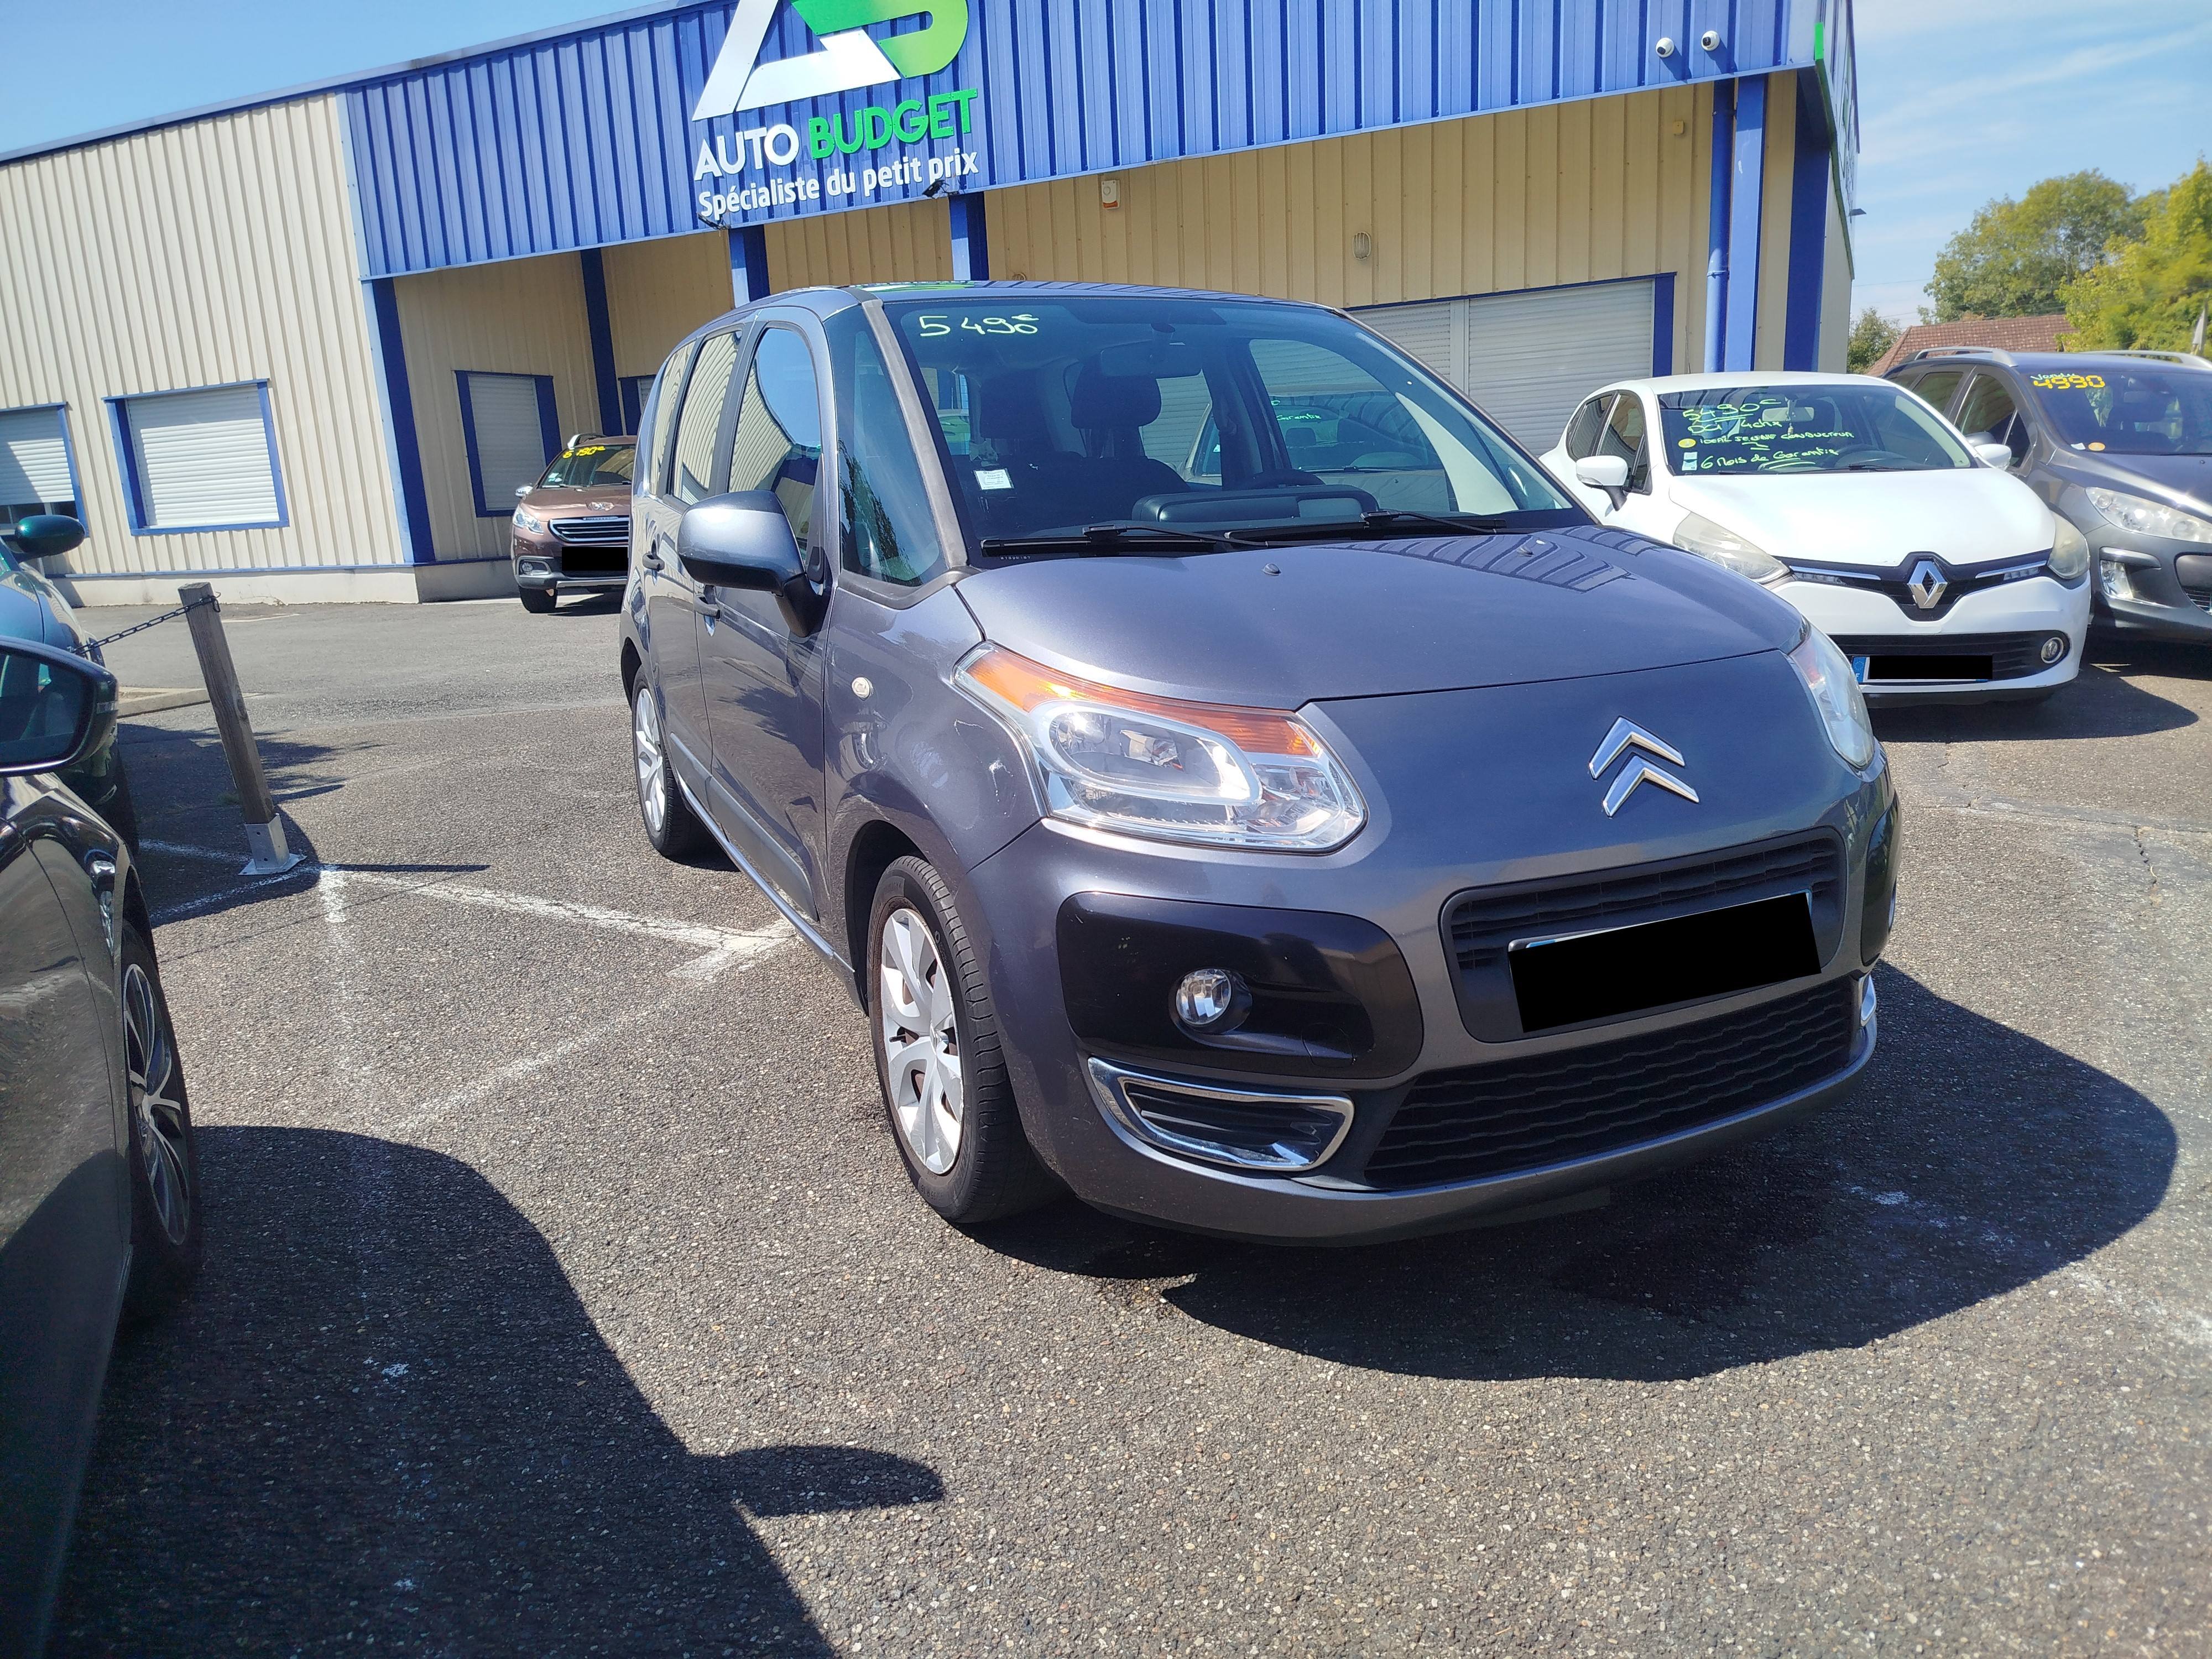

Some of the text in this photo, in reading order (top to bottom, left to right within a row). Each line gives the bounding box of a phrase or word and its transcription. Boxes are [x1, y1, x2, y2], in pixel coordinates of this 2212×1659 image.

[694, 123, 800, 181] AUTO
[808, 88, 978, 160] BUDGET
[699, 177, 820, 221] Spécialiste
[826, 168, 856, 196] du
[863, 156, 923, 197] petit
[928, 148, 979, 185] prix
